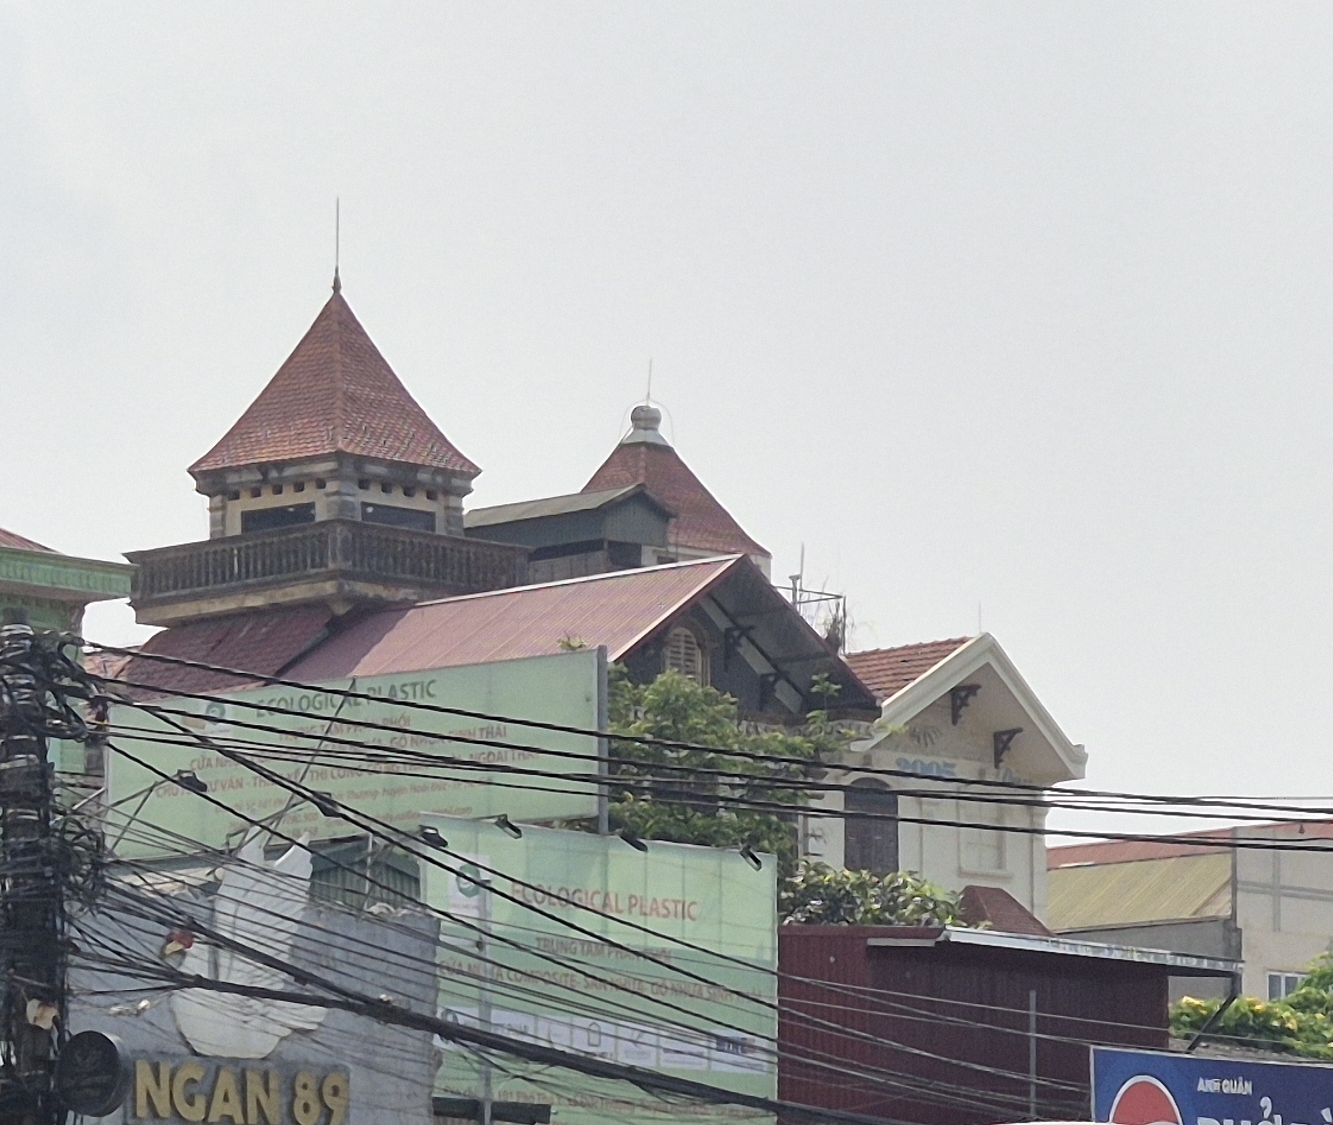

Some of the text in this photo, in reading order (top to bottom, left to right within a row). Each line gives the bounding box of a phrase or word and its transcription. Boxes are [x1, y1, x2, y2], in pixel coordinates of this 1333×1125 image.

[255, 678, 437, 719] ECOLOGICAL PLASTIC
[511, 881, 698, 922] ECOLOGICAL PLASTIC
[136, 1059, 281, 1125] NGAN
